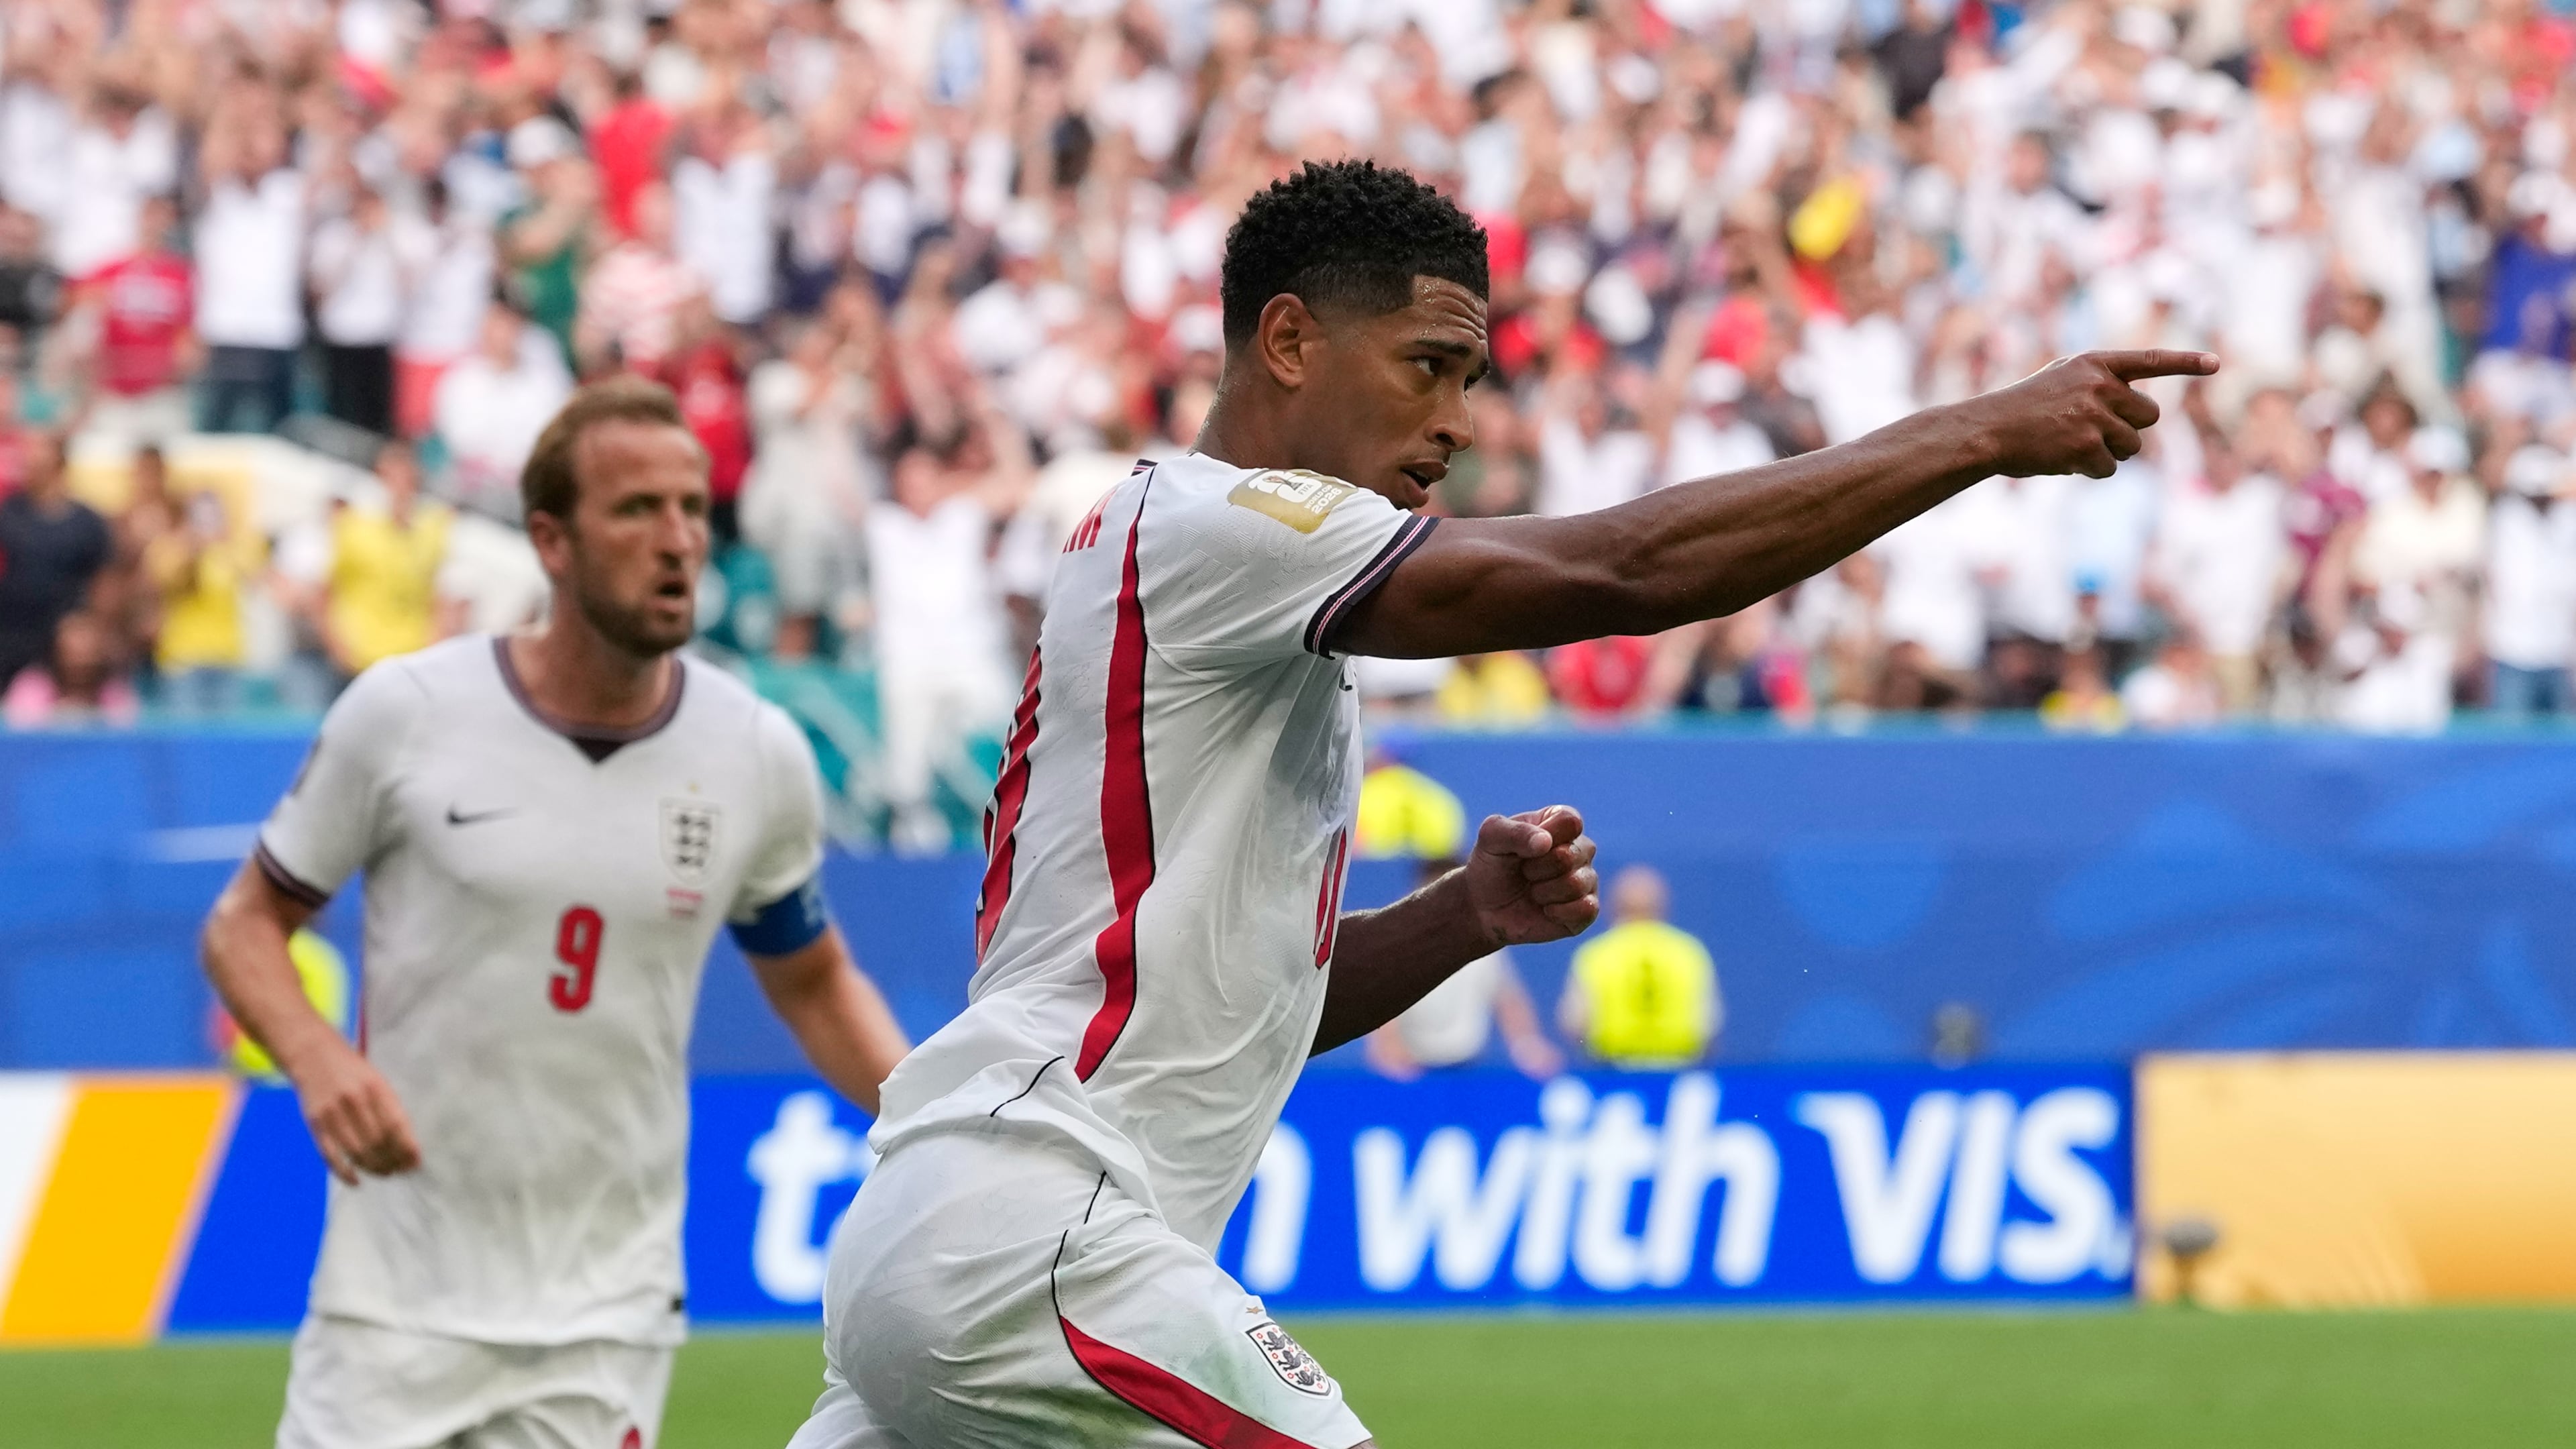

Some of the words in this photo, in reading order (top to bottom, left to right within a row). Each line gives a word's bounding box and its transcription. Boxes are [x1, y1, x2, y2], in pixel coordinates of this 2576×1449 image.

[1311, 488, 1342, 515] 2026
[549, 904, 604, 1013] 9
[1354, 1073, 1780, 1291] with
[1792, 1087, 2131, 1284] VIS
